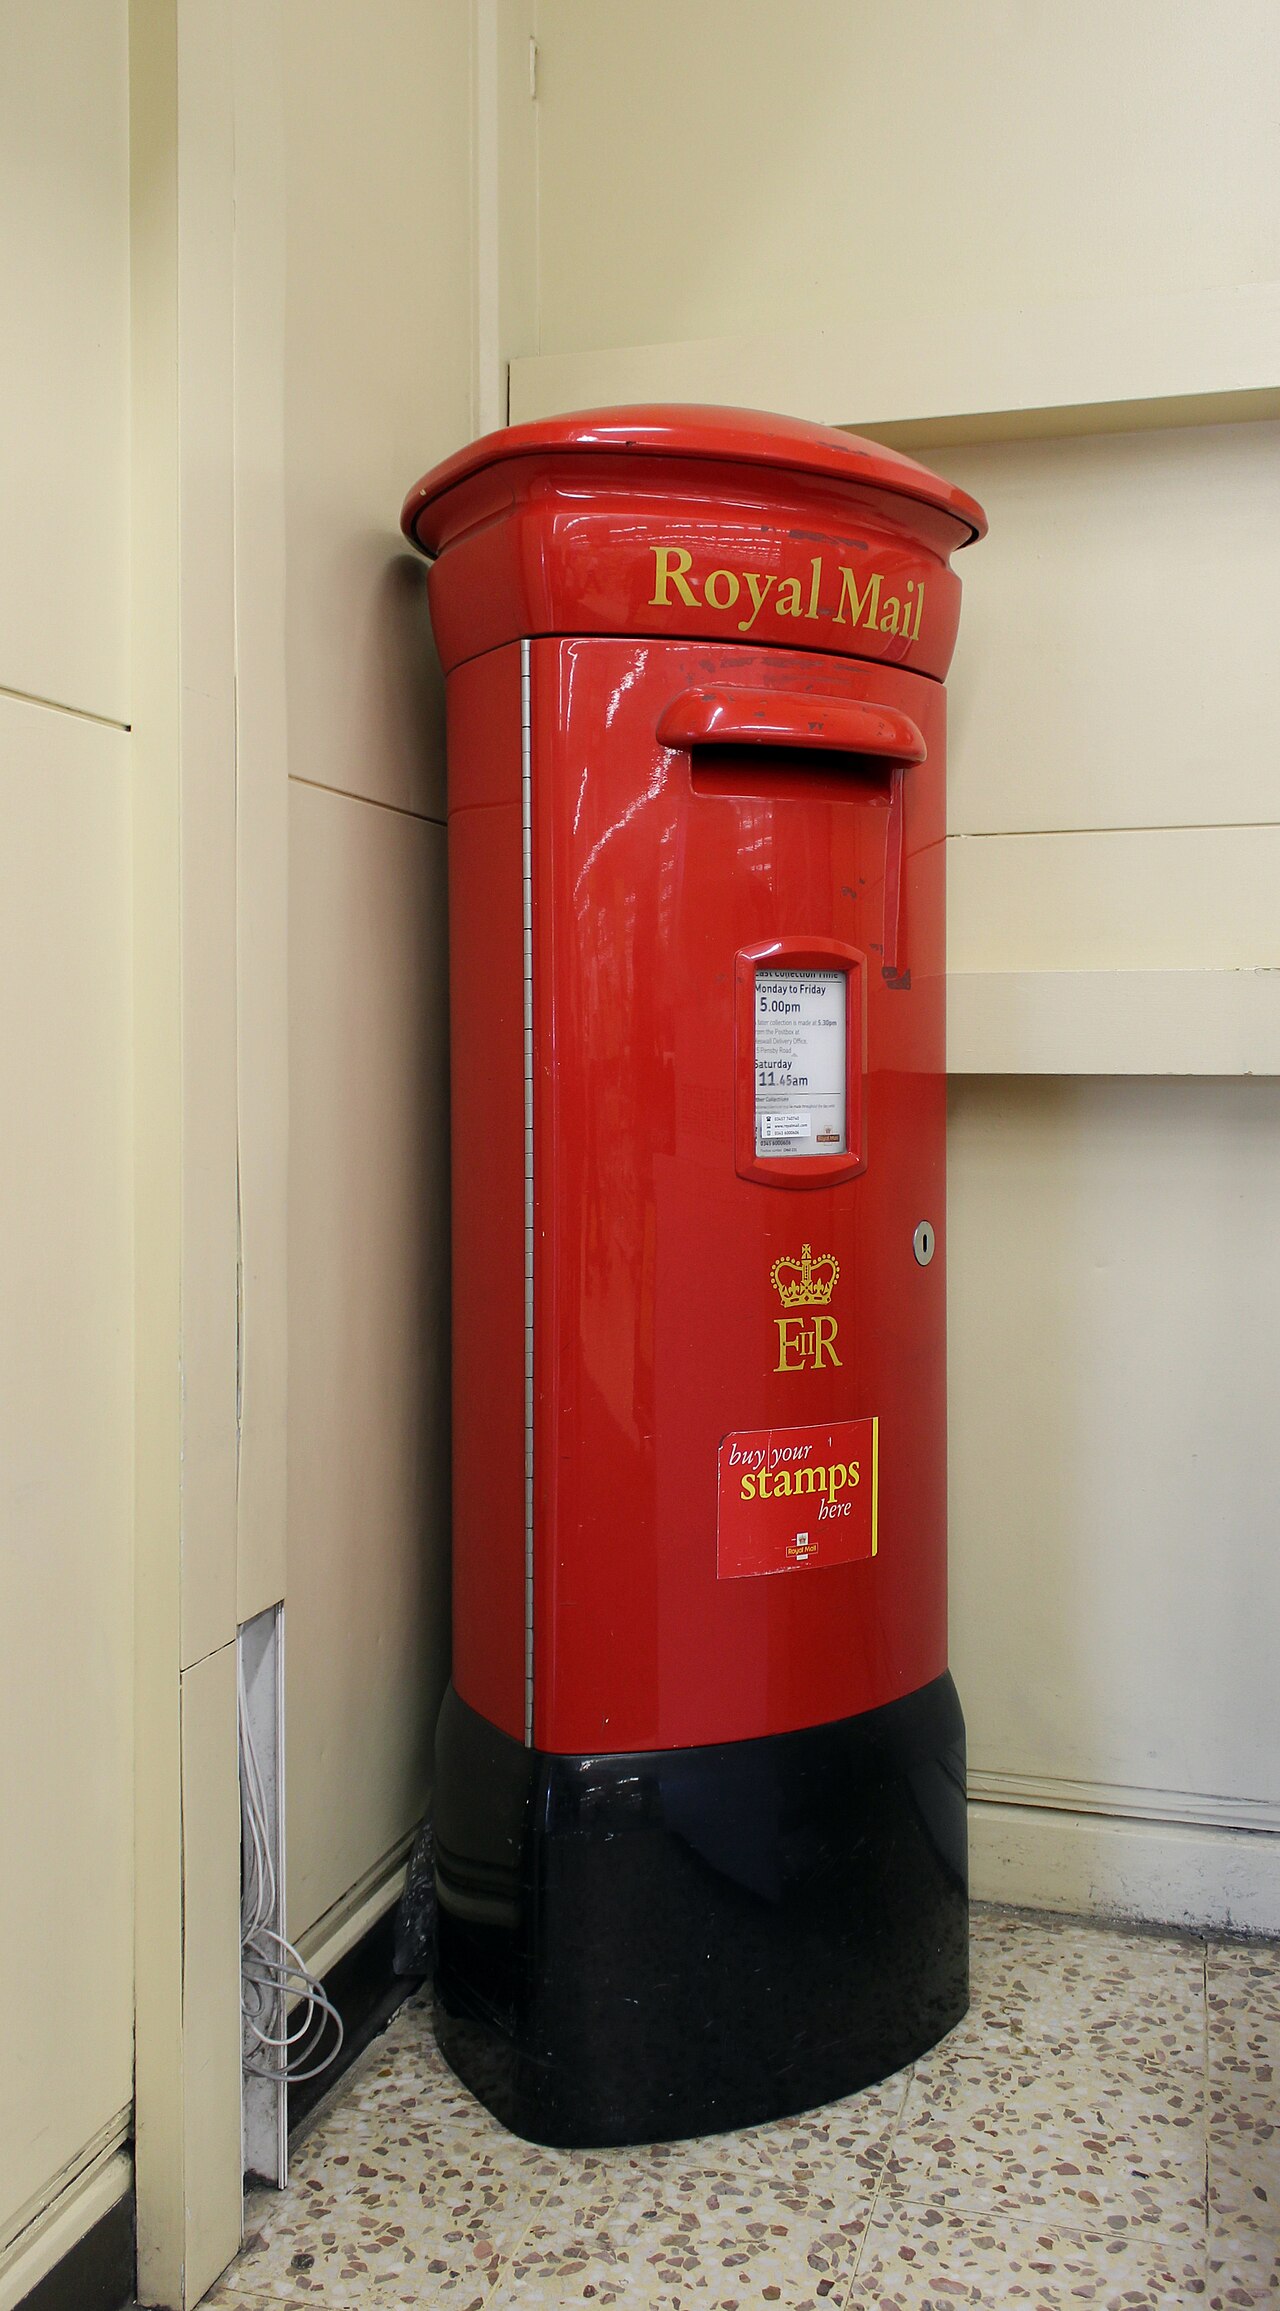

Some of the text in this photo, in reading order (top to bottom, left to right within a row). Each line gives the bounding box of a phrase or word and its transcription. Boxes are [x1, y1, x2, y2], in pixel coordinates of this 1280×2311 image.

[648, 546, 925, 641] Royal Mail
[755, 983, 826, 996] Monday to Friday
[760, 997, 800, 1015] 5.00pm
[754, 1059, 792, 1071] Saturday
[759, 1071, 808, 1087] 11.45am
[729, 1443, 812, 1470] buy your
[740, 1461, 860, 1504] stamps
[818, 1498, 852, 1521] here
[787, 1544, 817, 1555] Royal Mail
